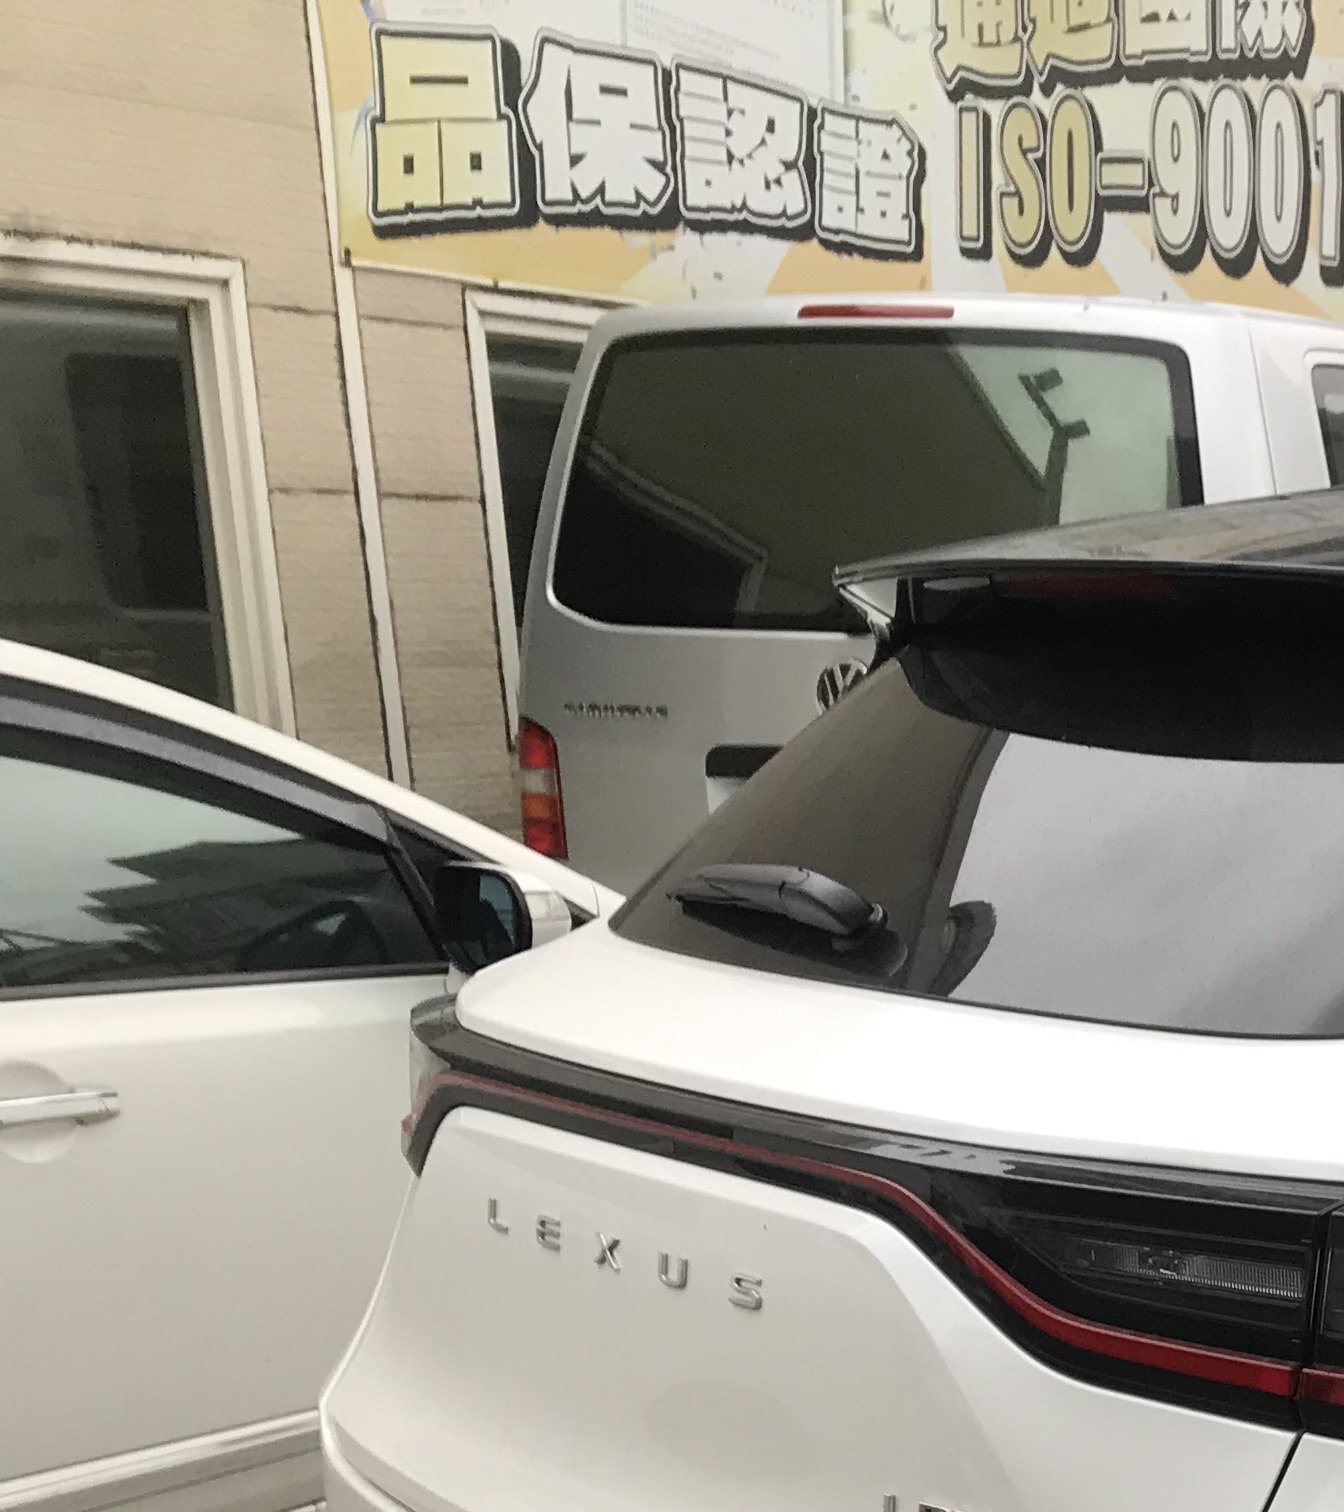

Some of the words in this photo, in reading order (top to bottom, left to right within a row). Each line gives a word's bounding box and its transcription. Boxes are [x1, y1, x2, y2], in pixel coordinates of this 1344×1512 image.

[370, 24, 922, 256] 品保認證
[487, 1197, 764, 1312] LEXUS
